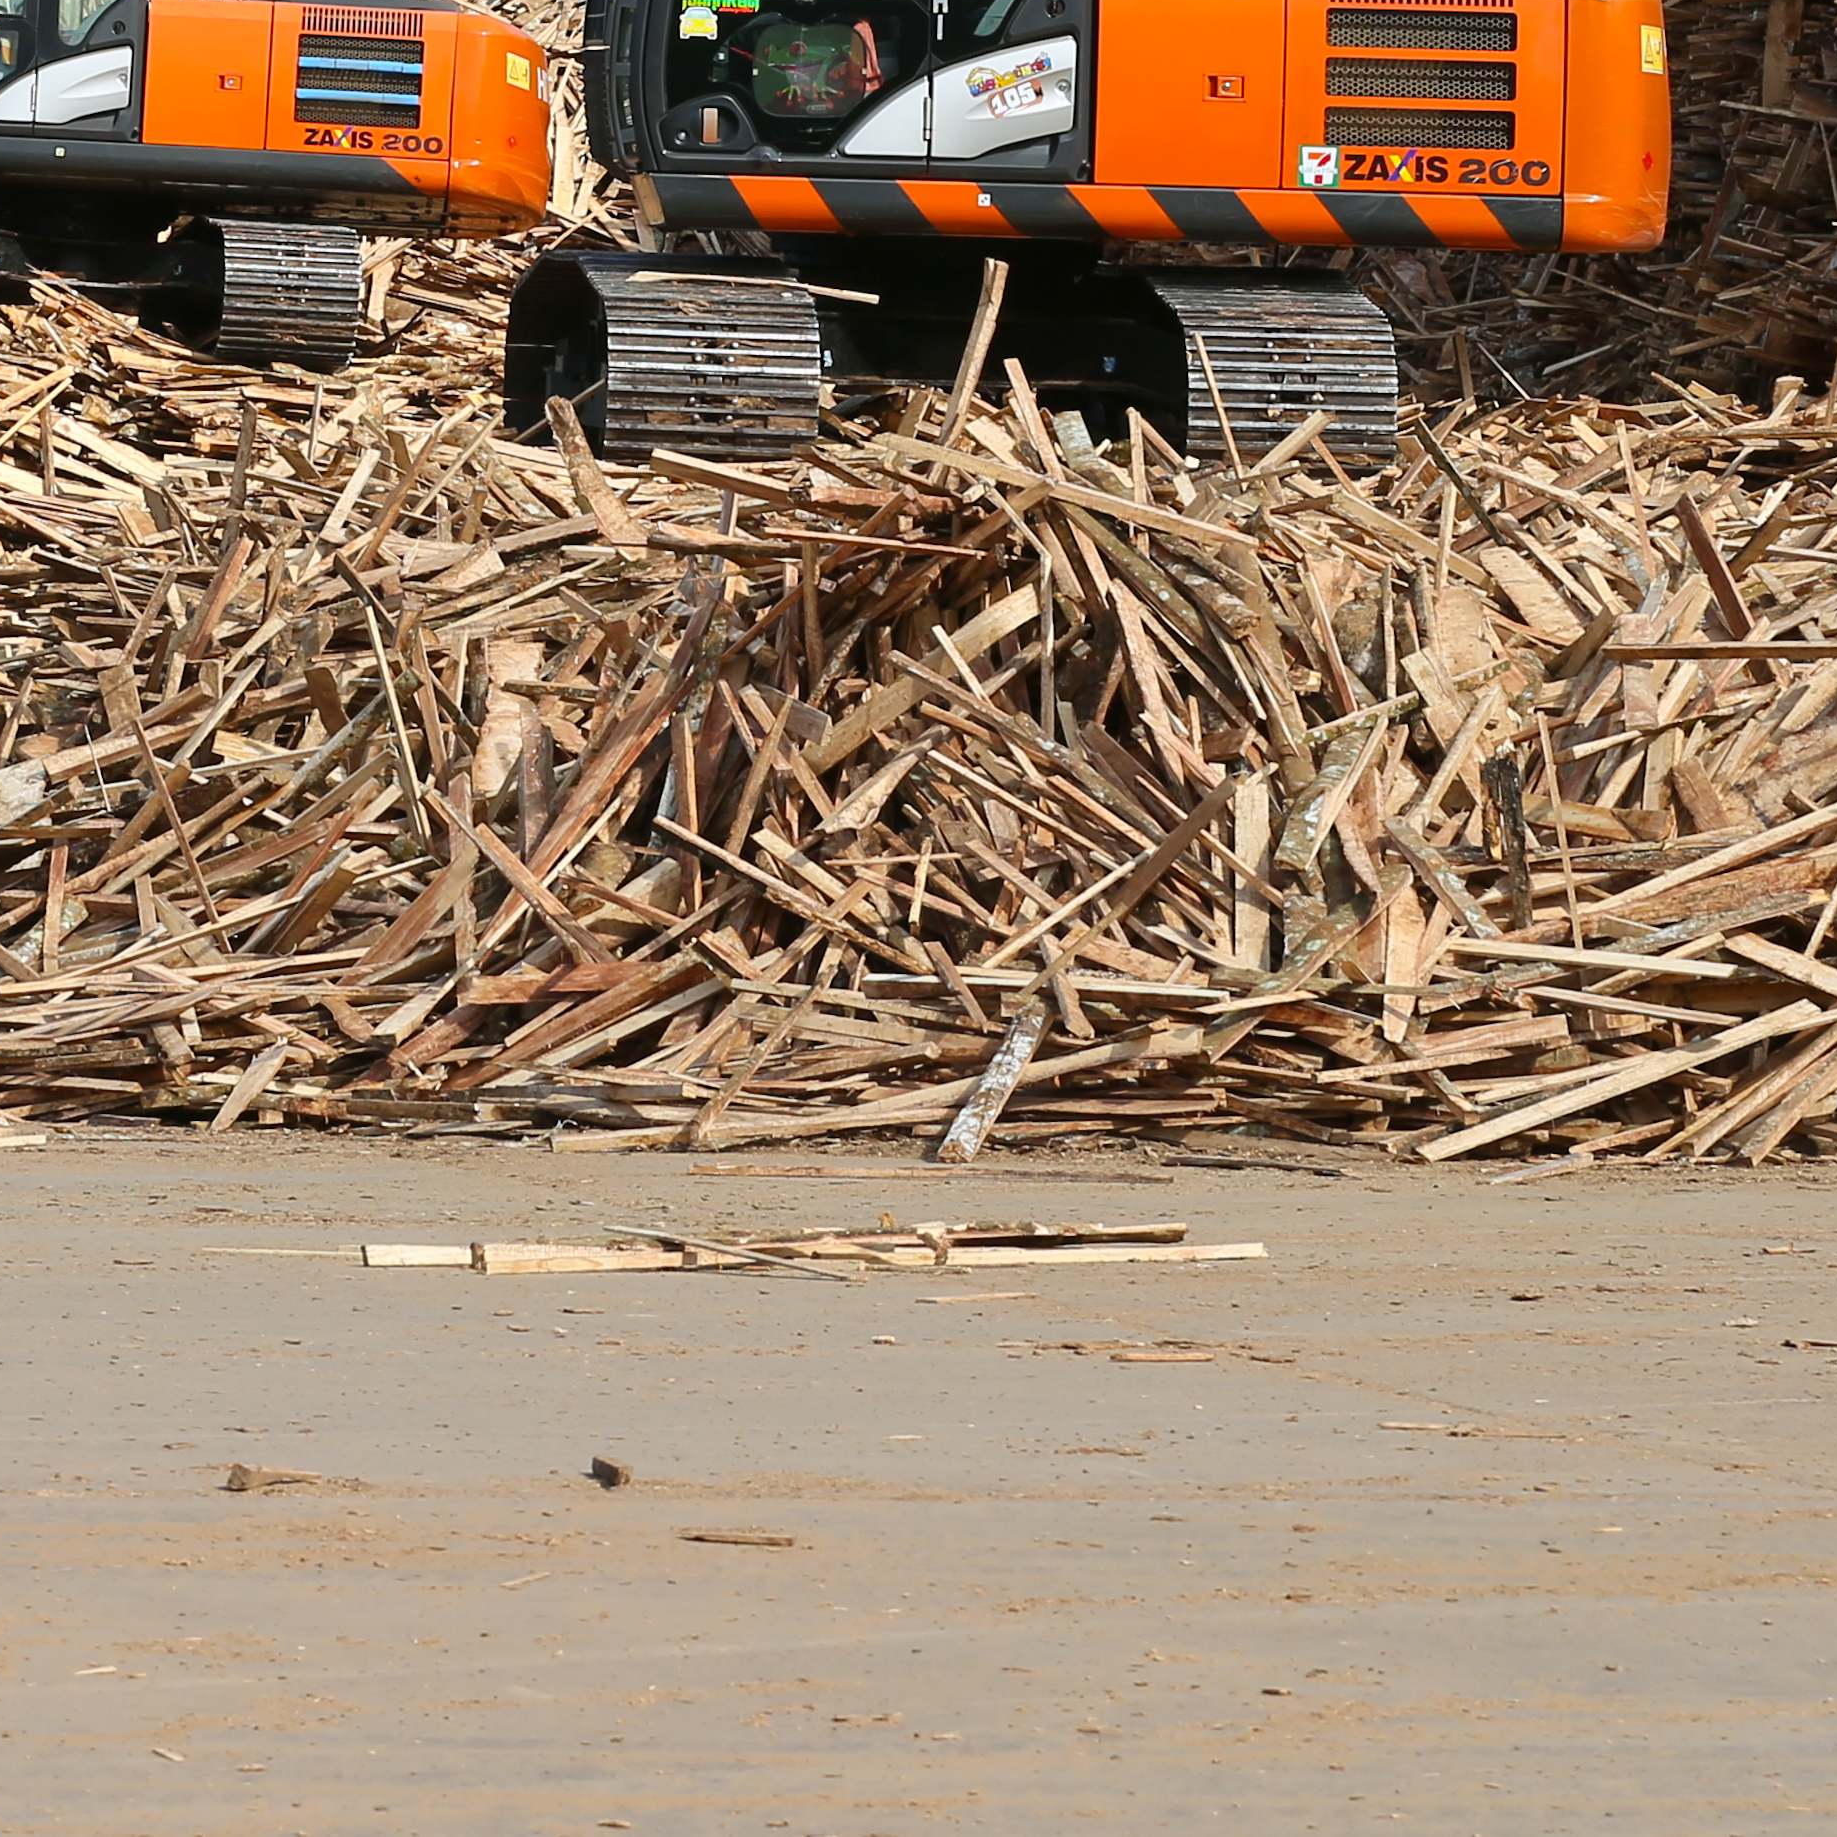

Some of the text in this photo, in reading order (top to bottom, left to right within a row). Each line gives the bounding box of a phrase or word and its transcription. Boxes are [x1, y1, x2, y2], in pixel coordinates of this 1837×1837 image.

[990, 81, 1037, 115] 105
[303, 126, 443, 154] ZAXIS 200
[1343, 149, 1550, 186] ZAXIS 200
